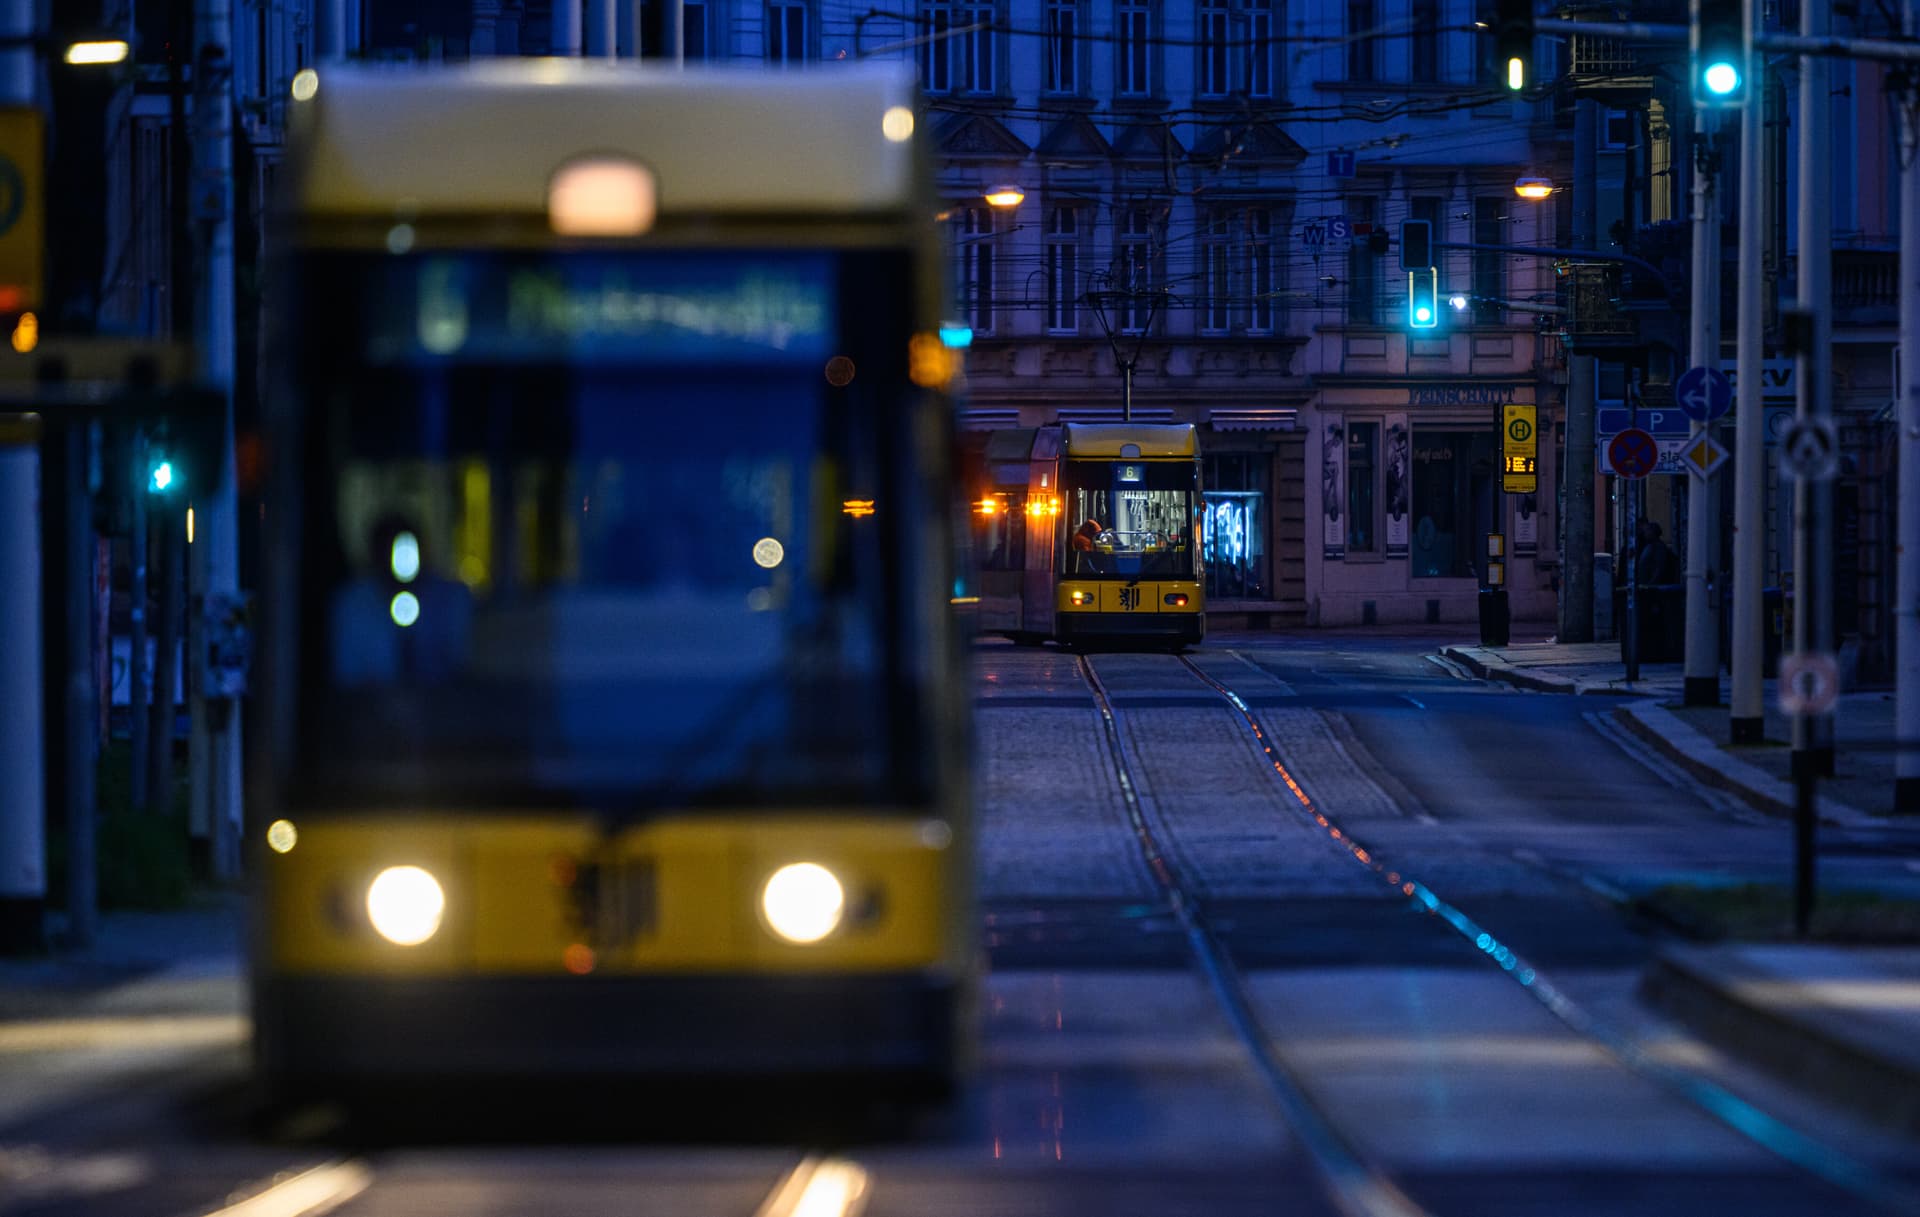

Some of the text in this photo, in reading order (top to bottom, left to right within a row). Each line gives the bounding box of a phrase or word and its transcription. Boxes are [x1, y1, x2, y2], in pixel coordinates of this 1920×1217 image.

[1334, 154, 1348, 174] T
[1306, 230, 1323, 243] W
[1333, 222, 1347, 238] S
[1650, 412, 1664, 431] P
[1515, 423, 1525, 437] H
[1126, 466, 1134, 478] 6
